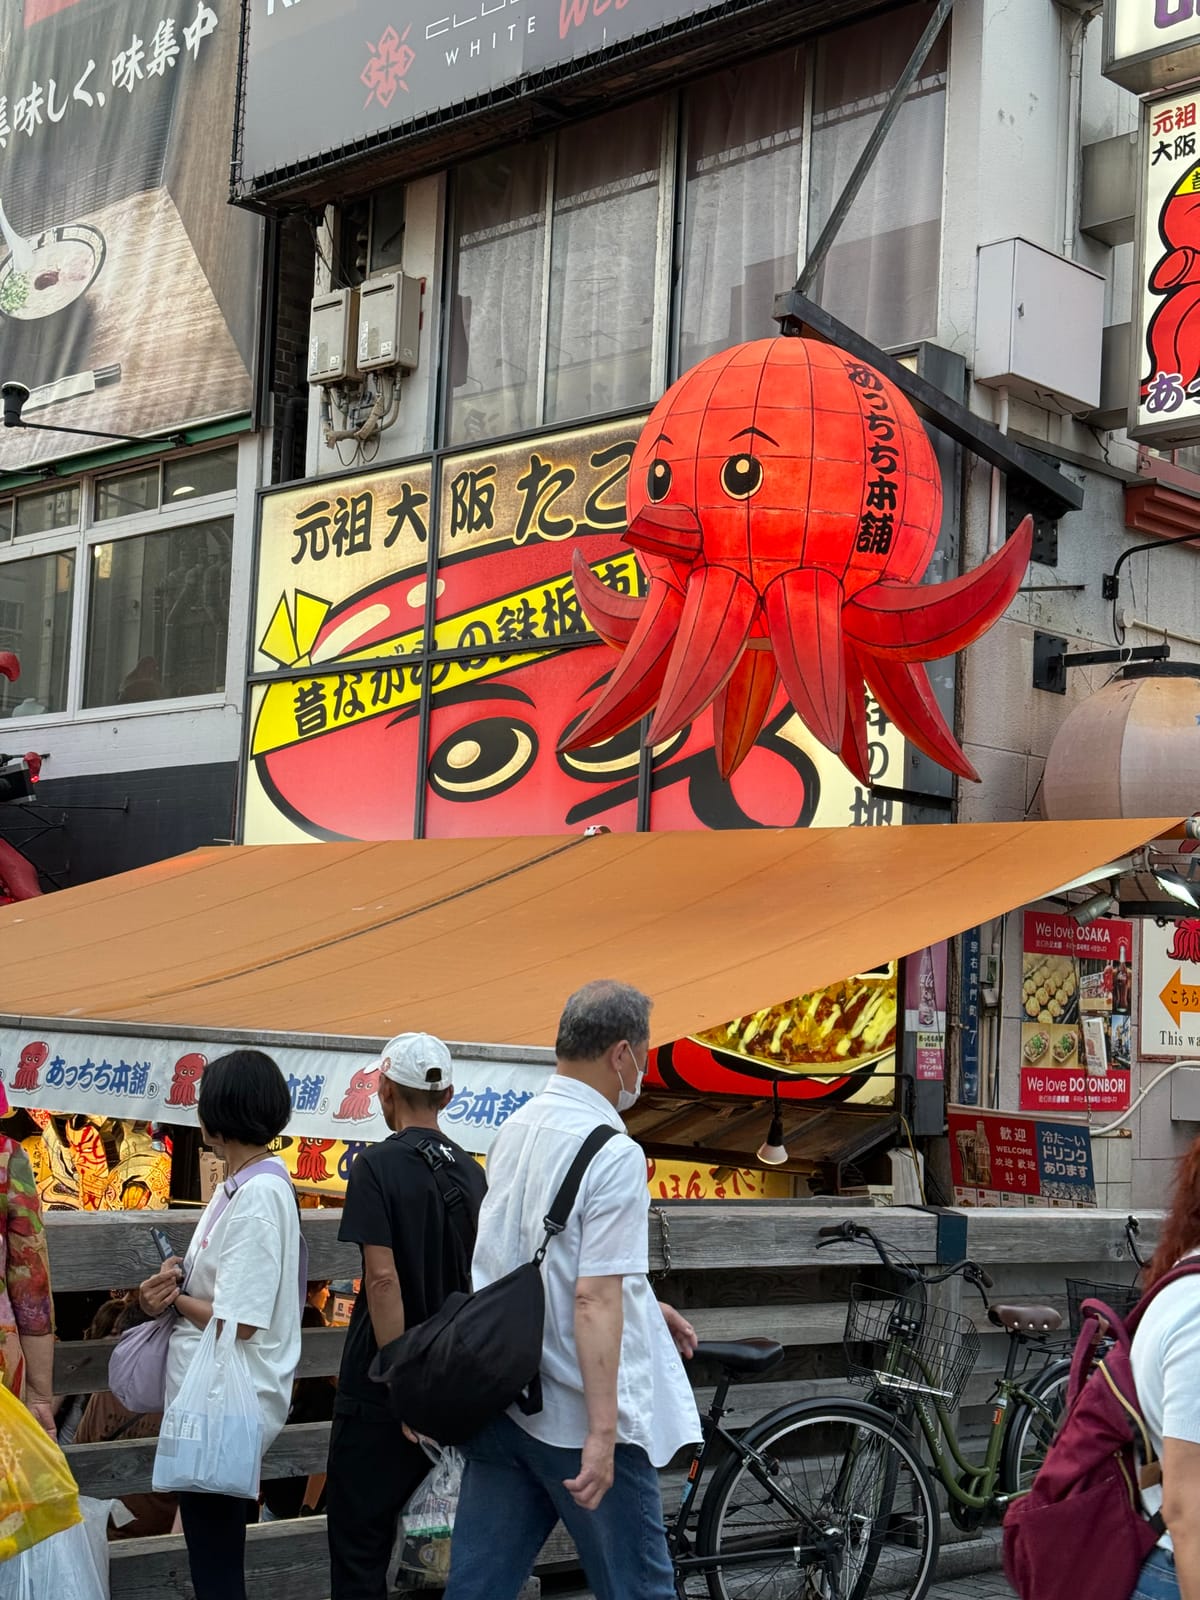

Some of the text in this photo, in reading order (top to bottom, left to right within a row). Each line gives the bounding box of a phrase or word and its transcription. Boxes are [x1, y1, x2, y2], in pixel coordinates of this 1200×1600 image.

[446, 15, 536, 67] WHITE
[1152, 102, 1197, 137] 元祖
[1151, 131, 1197, 166] 大阪
[845, 359, 899, 556] あっちち本舗
[1035, 921, 1111, 944] We love OSAKA
[1159, 1030, 1183, 1047] This
[46, 1055, 151, 1096] あっちち本舗
[1027, 1076, 1126, 1093] We love DOONBORI
[995, 1145, 1033, 1157] WELCOME
[1043, 1145, 1087, 1163] ドリンク
[1044, 1162, 1089, 1178] あります
